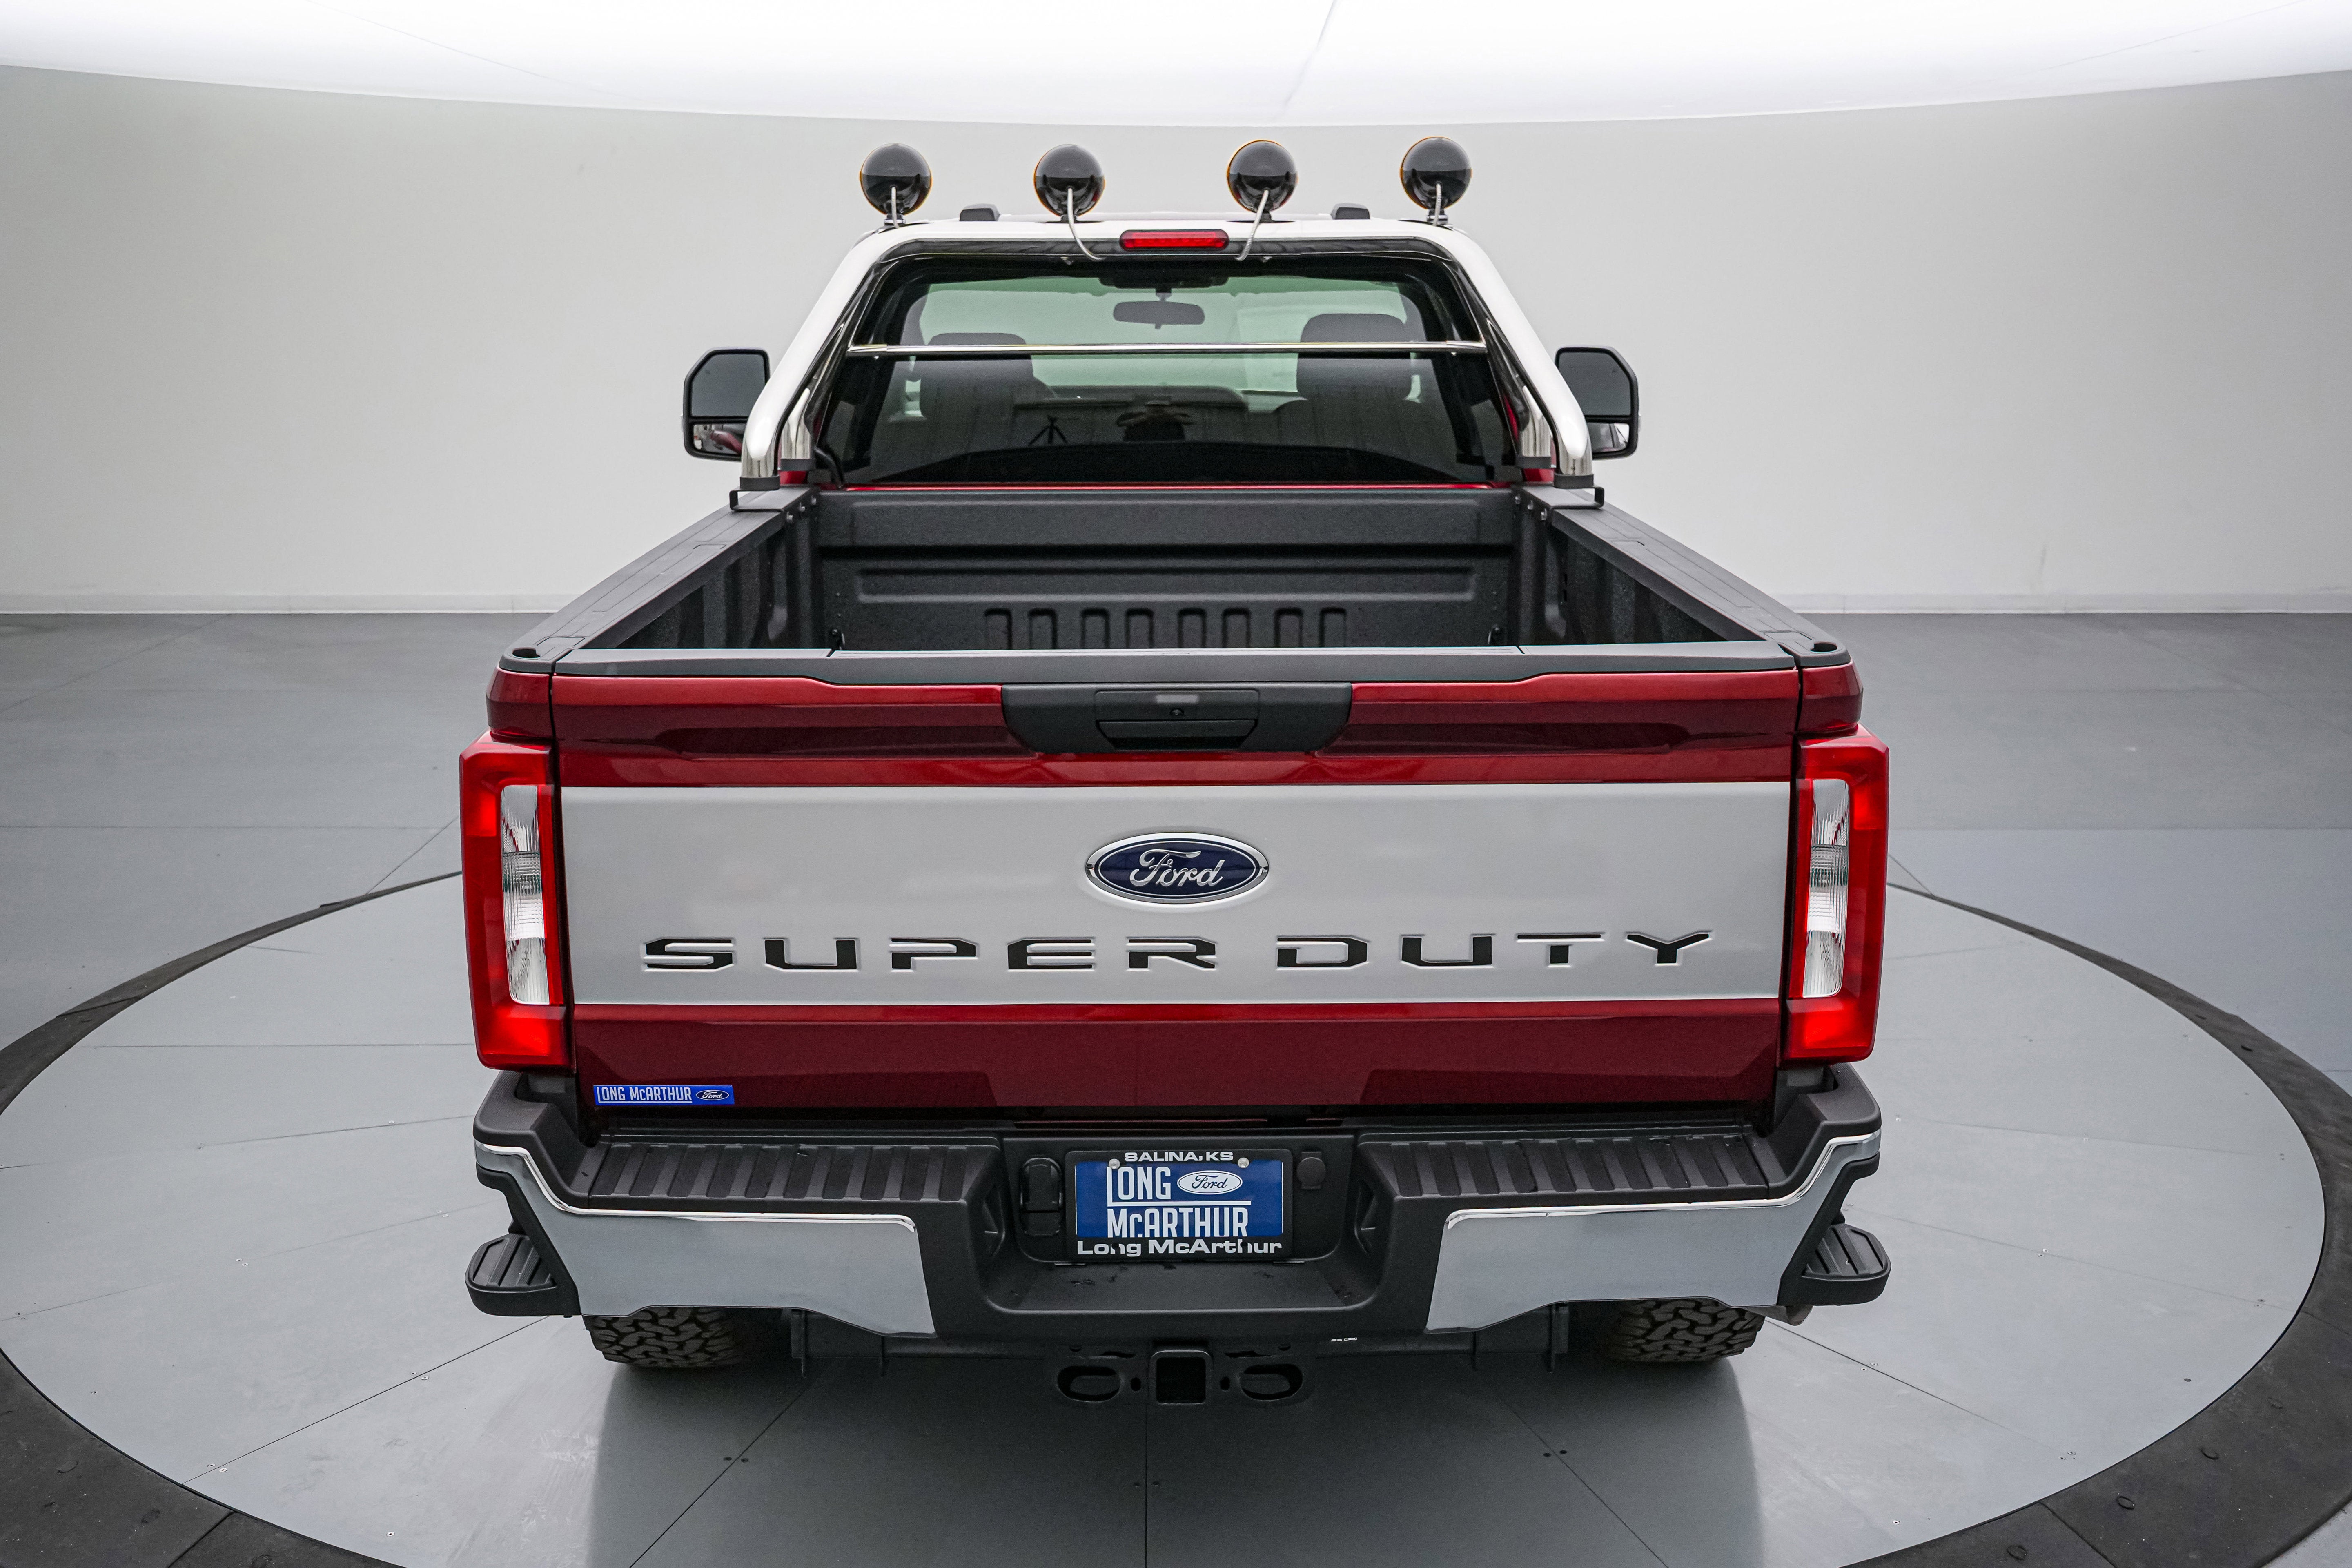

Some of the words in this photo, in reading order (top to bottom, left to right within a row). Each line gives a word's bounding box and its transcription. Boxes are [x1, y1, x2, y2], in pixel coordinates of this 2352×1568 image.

[1129, 849, 1225, 886] Ford
[644, 937, 1217, 972] SUPER
[1276, 931, 1711, 969] DUTY
[597, 1087, 625, 1103] LONG
[630, 1087, 692, 1101] McARTHUR
[1124, 1152, 1203, 1162] SALINA,
[1205, 1151, 1234, 1162] KS
[1107, 1166, 1172, 1206] LONG
[1191, 1175, 1227, 1189] Ford
[1107, 1207, 1248, 1238] McARTHUR
[1077, 1240, 1141, 1257] Long
[1148, 1238, 1282, 1254] McArthur
